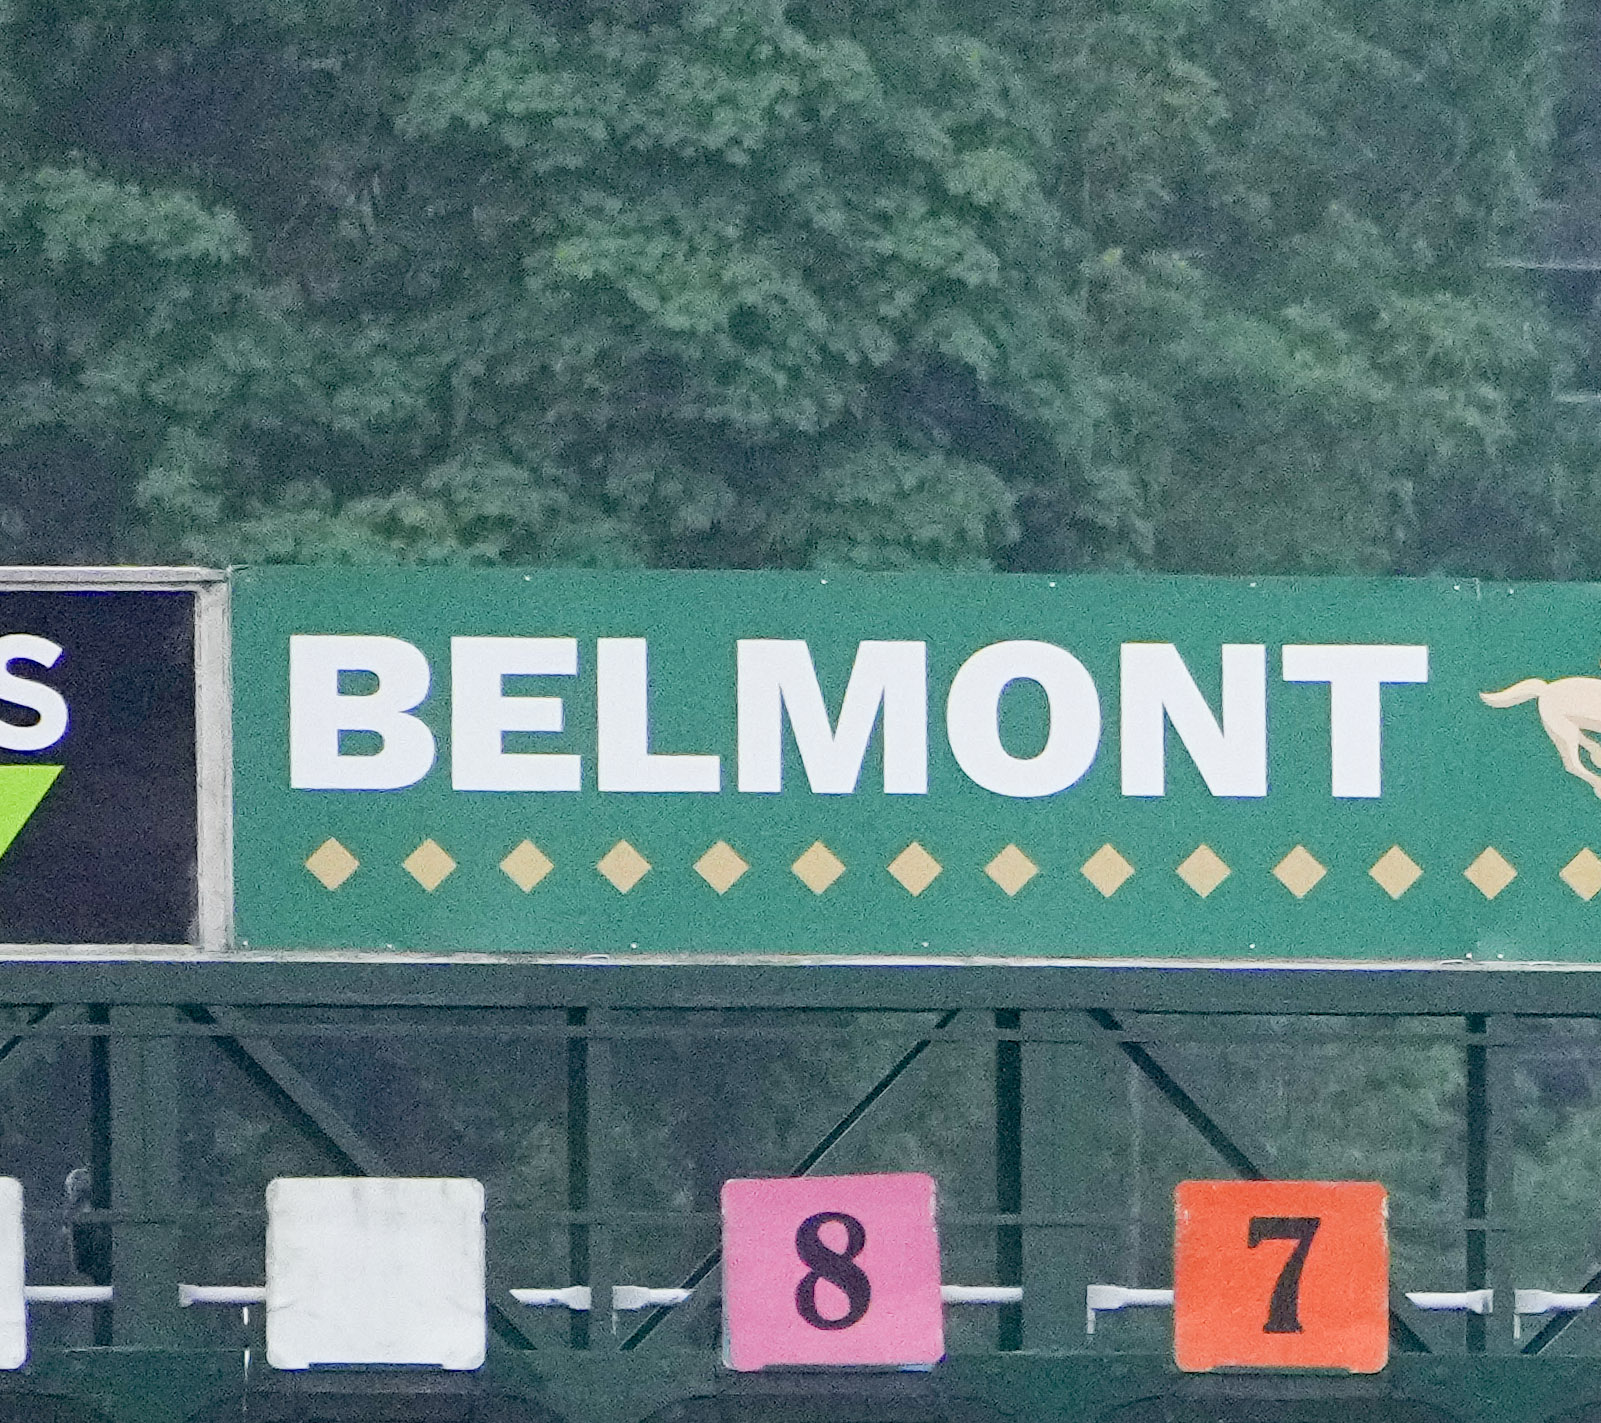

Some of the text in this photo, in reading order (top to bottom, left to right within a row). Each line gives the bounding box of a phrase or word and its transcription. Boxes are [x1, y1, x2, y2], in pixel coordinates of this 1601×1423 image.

[289, 634, 1430, 798] BELMONT
[796, 1211, 871, 1330] 8
[1247, 1216, 1320, 1333] 7
